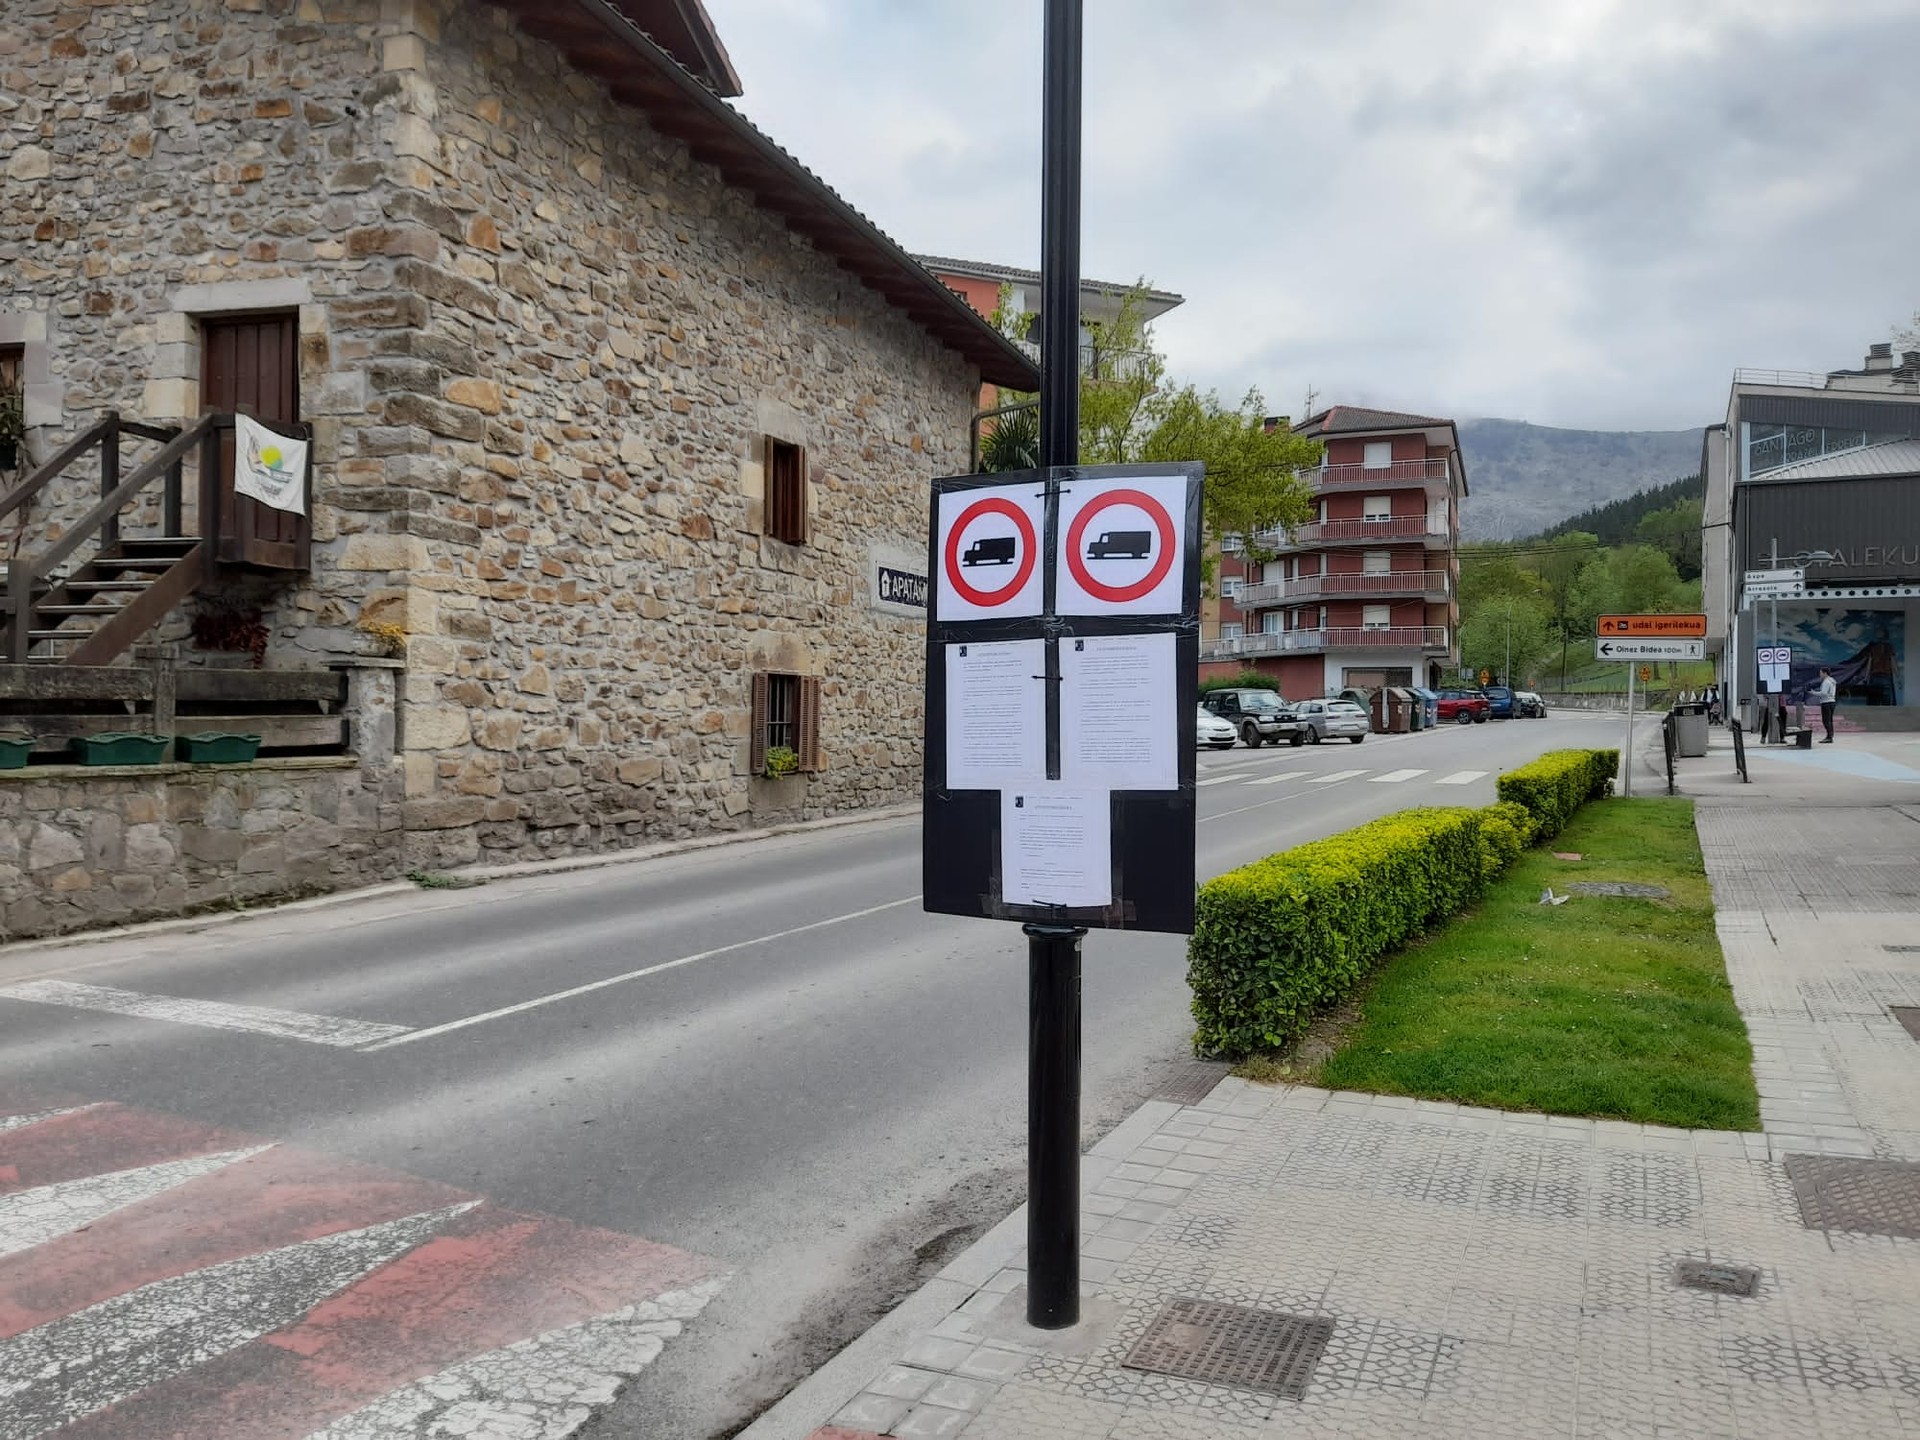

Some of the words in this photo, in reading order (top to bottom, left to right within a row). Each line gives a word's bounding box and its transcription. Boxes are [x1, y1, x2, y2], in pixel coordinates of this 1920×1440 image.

[1756, 428, 1815, 455] SANTAGO
[1632, 621, 1652, 629] udal
[1655, 621, 1701, 630] igerilekua
[1616, 645, 1637, 653] Oinez
[1640, 645, 1662, 653] Bidea
